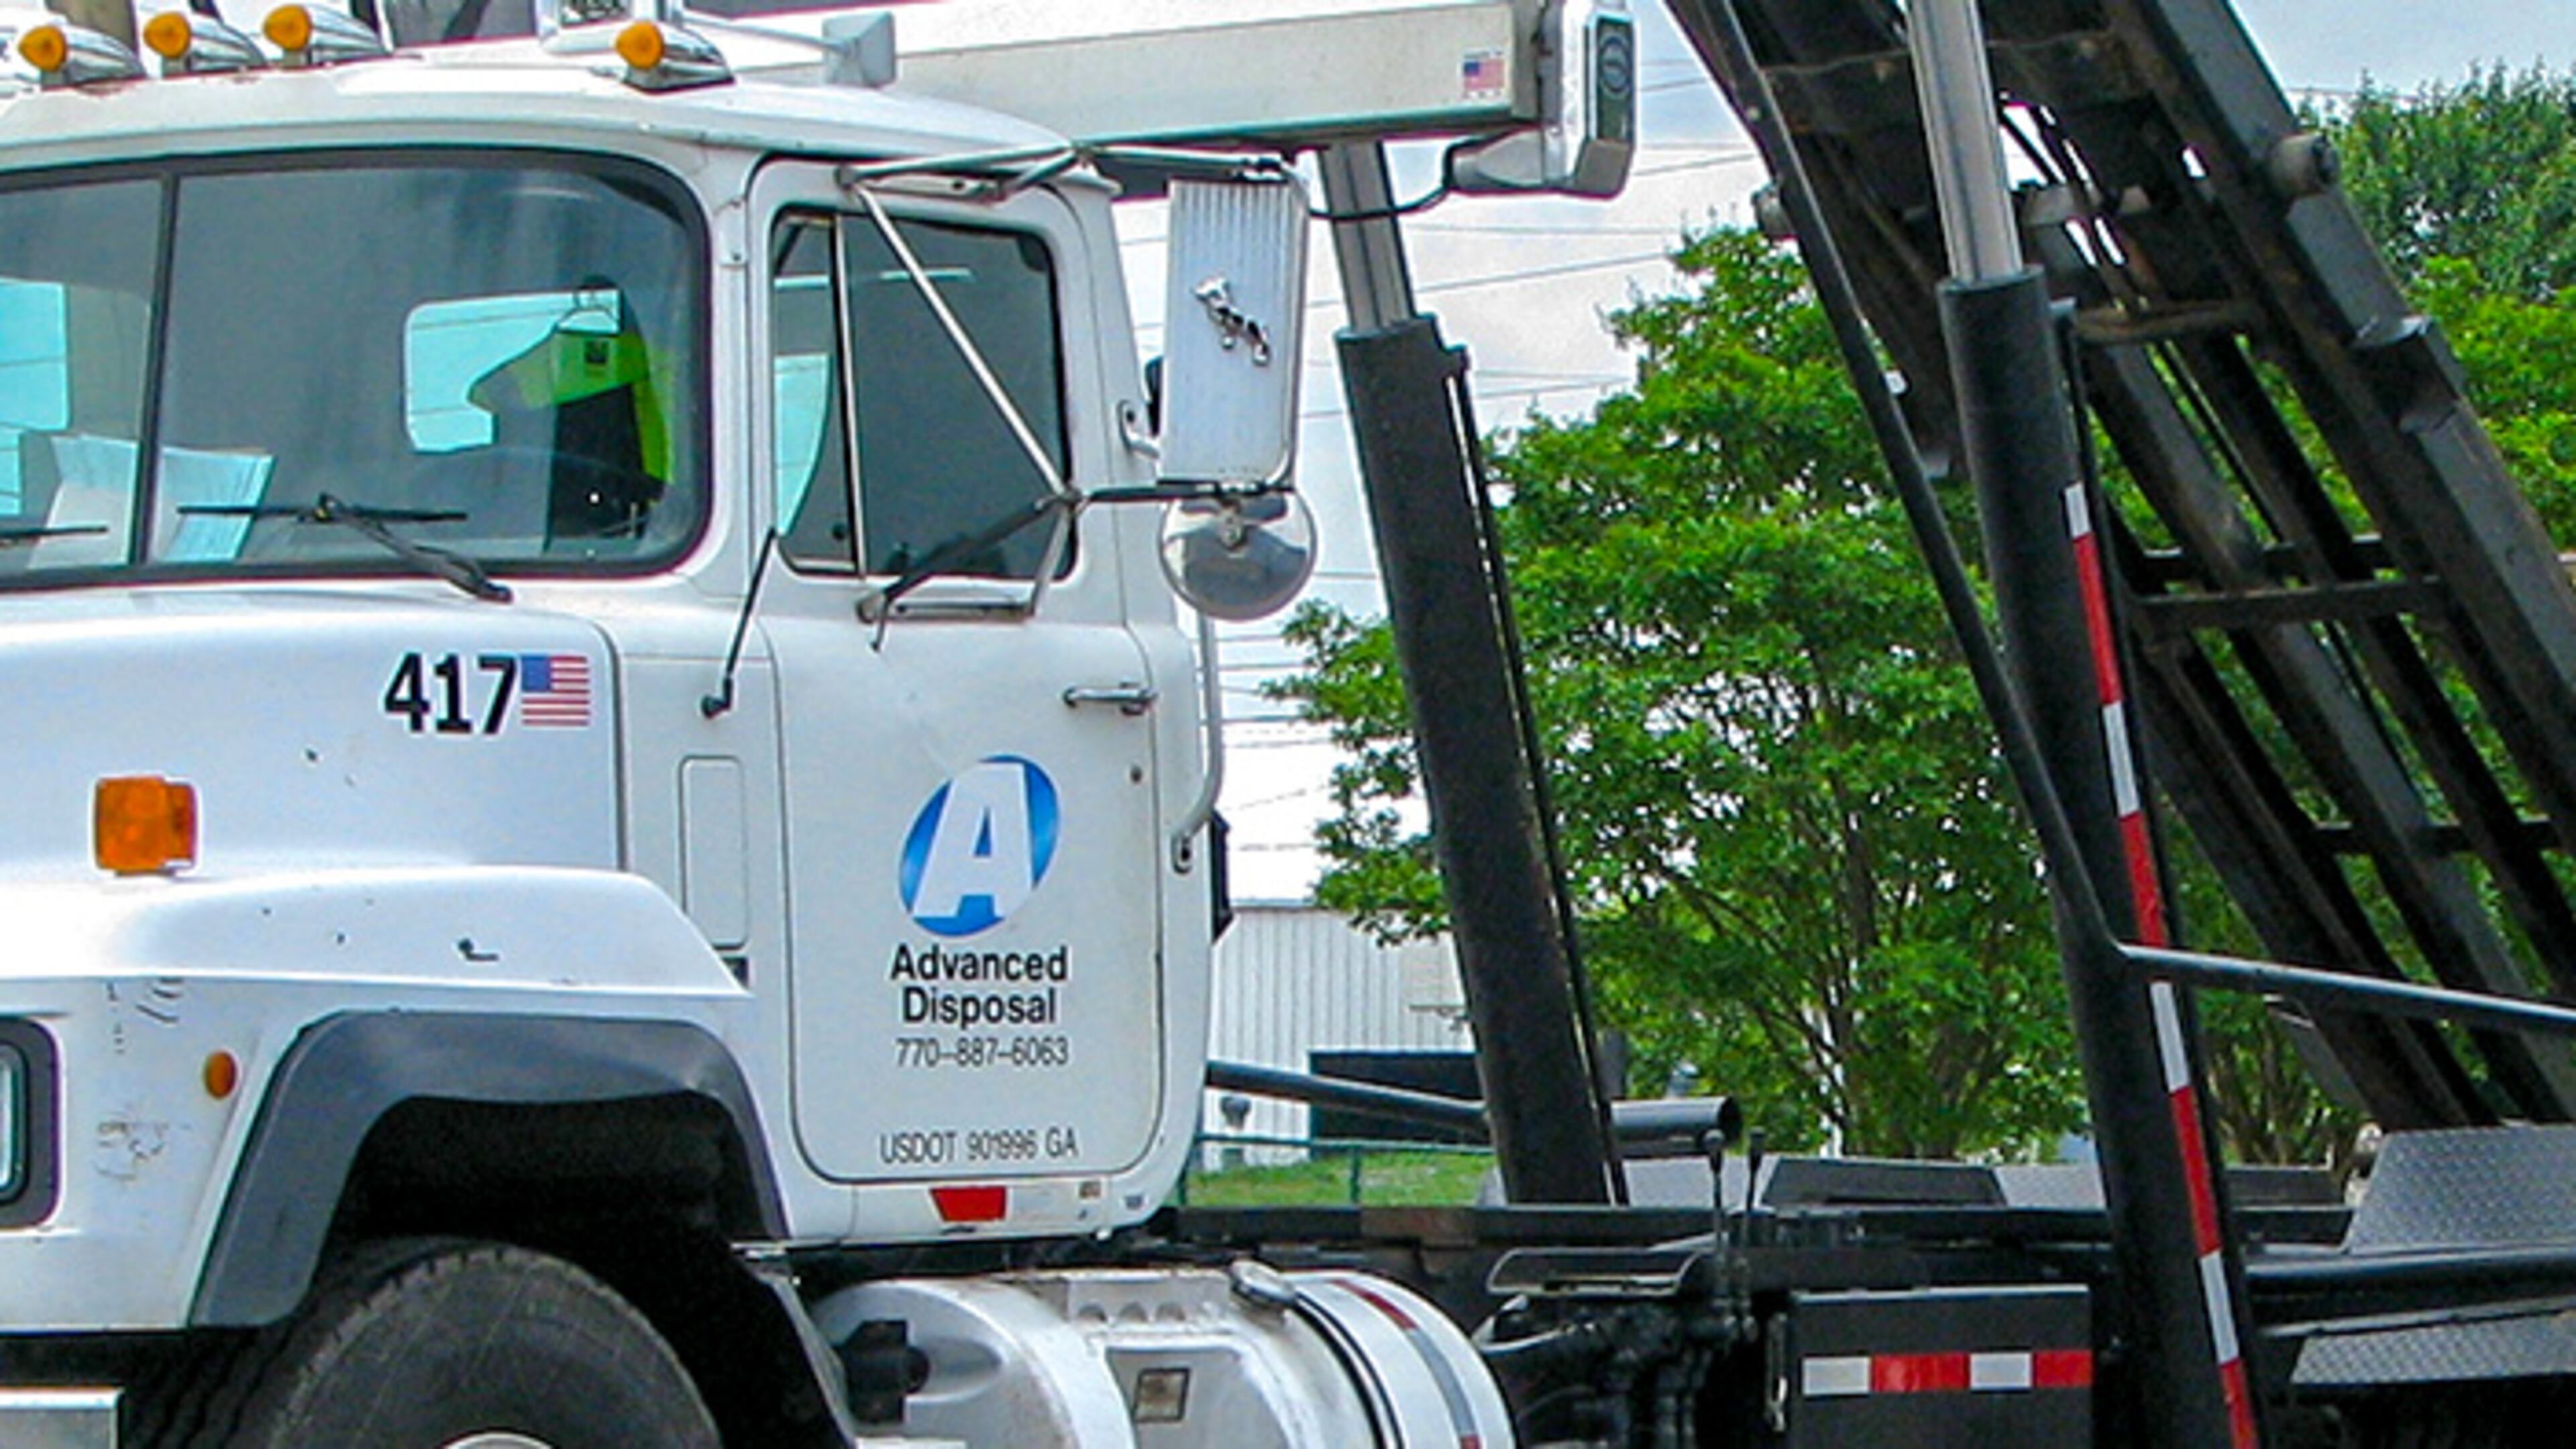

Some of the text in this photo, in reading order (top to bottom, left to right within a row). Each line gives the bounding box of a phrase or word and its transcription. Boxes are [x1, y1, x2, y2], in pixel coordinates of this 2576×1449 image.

[384, 651, 517, 735] 417
[890, 943, 1068, 980] Advanced
[902, 987, 1055, 1030] Disposal
[880, 1130, 957, 1164] USDOT
[1044, 1126, 1079, 1159] GA
